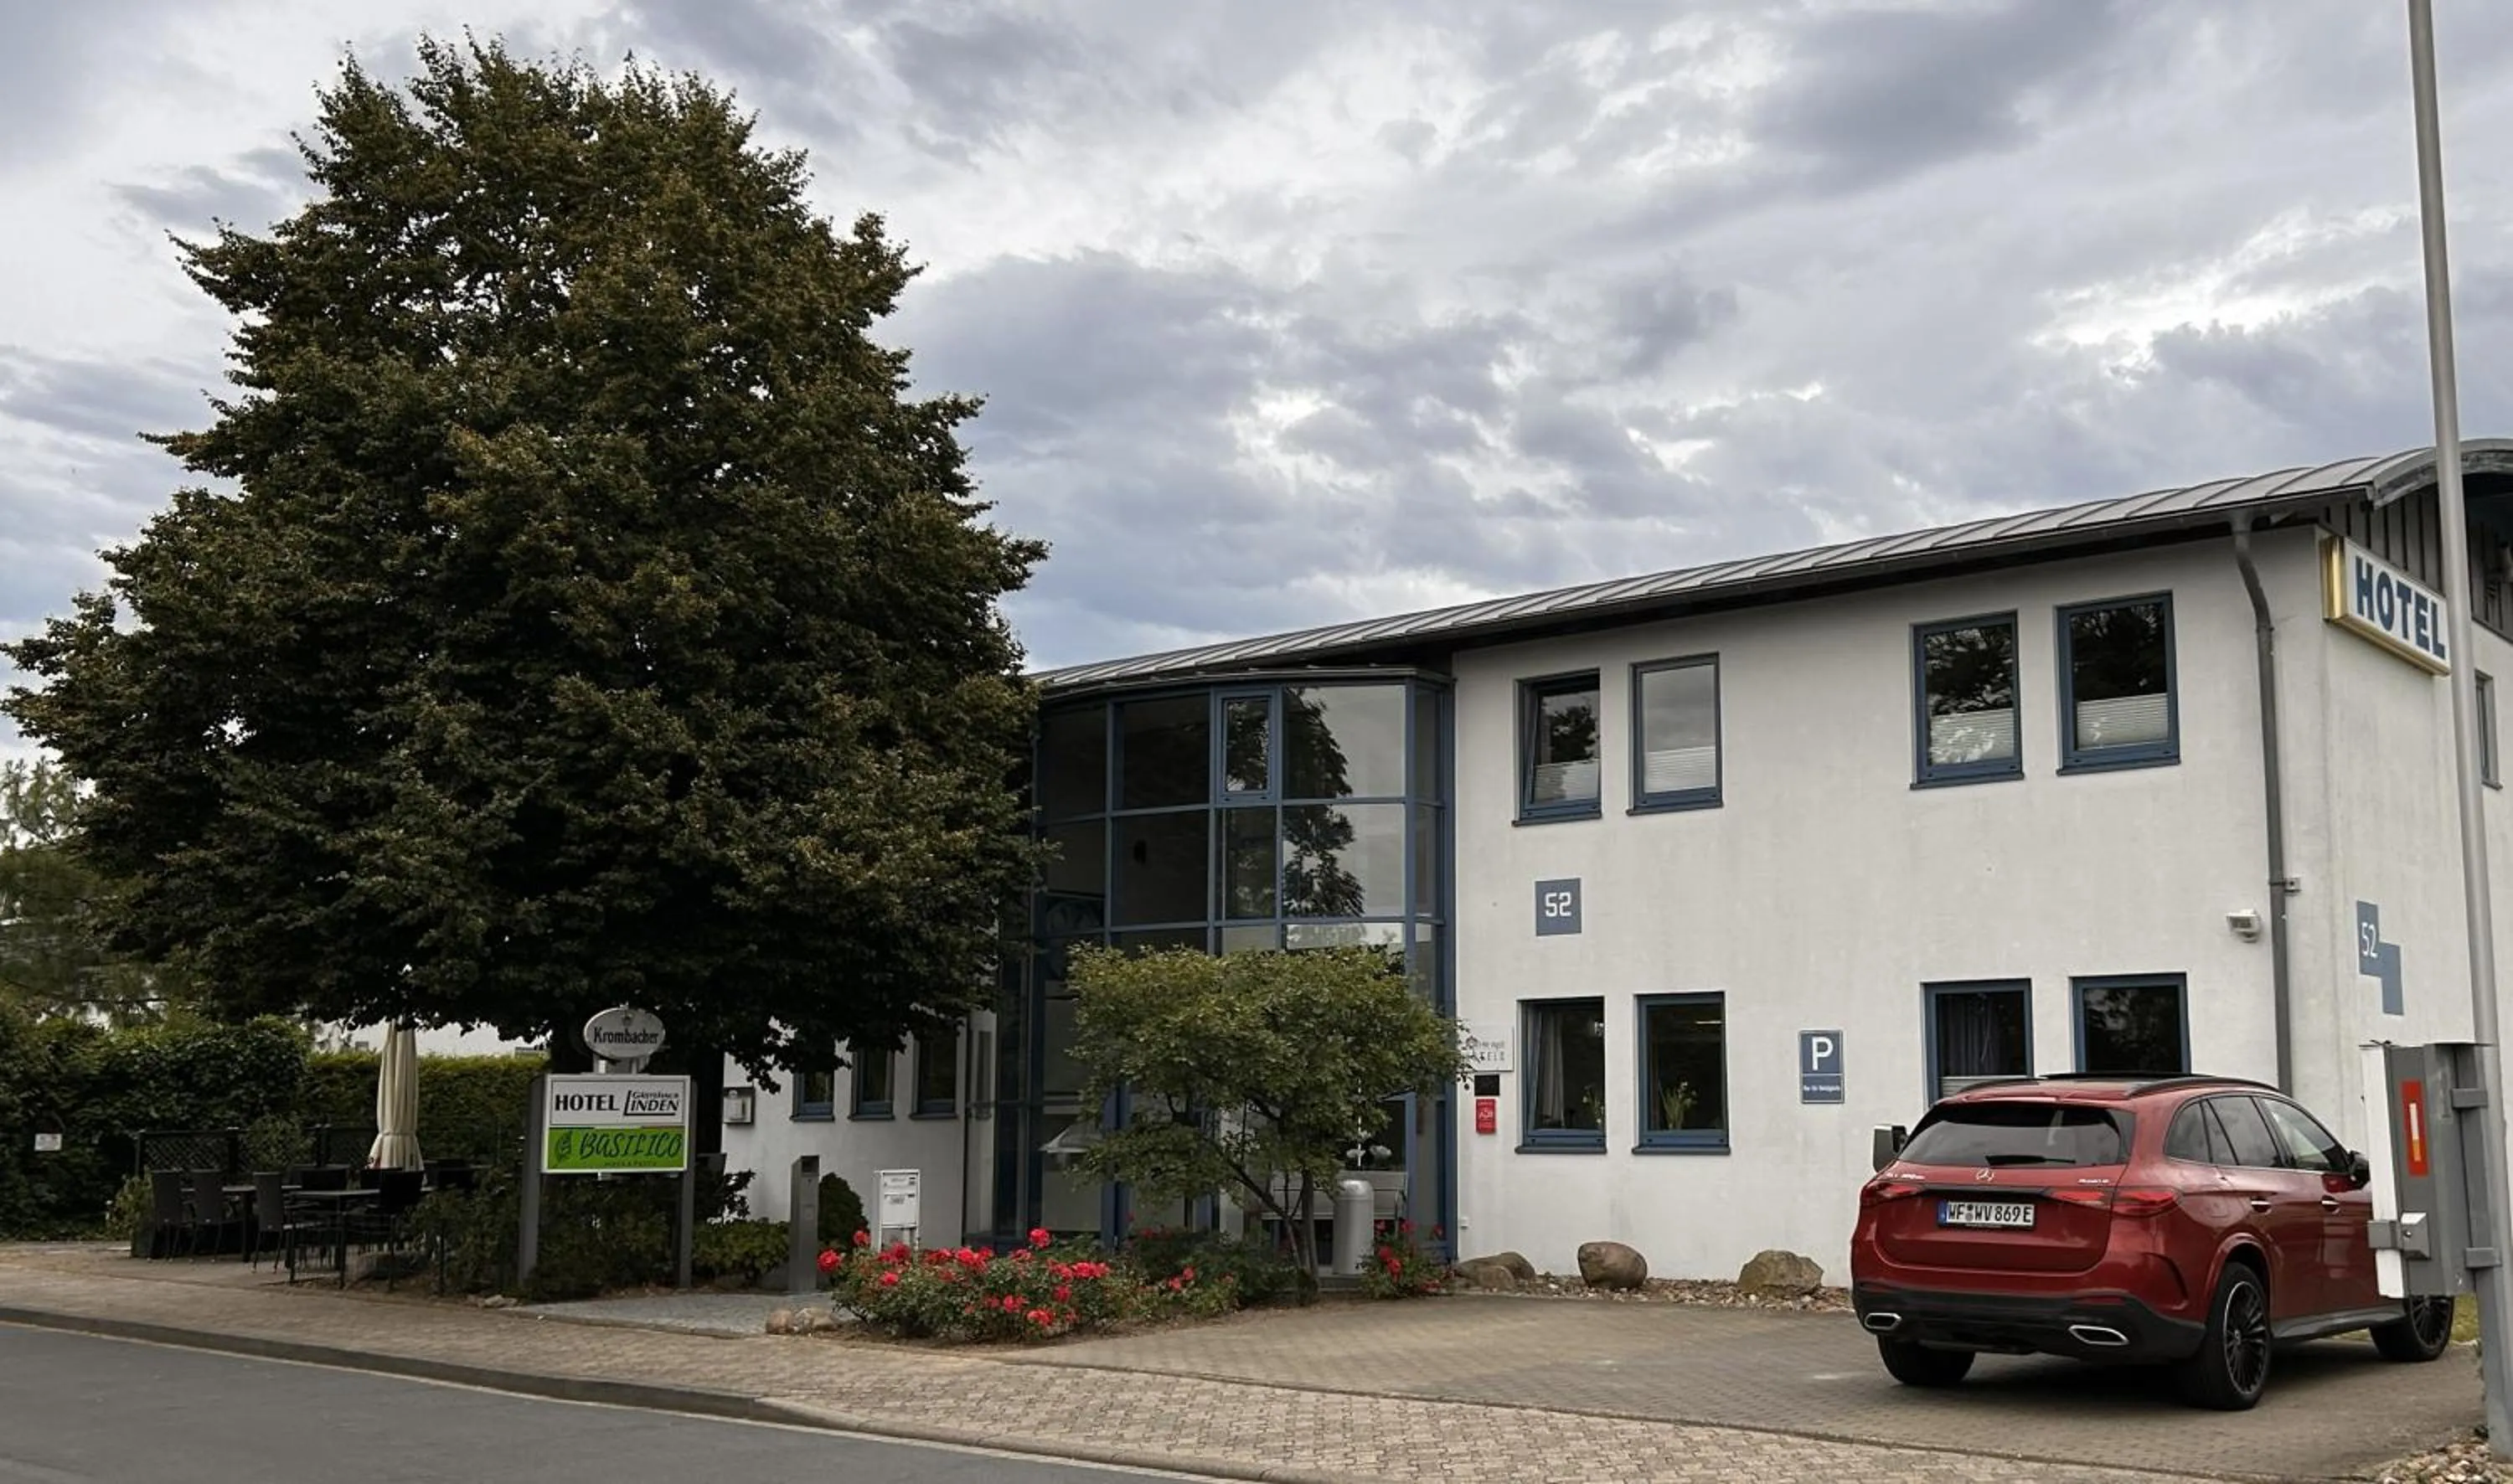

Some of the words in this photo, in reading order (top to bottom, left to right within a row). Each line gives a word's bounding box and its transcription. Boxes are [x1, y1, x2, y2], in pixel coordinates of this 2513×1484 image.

[2356, 555, 2445, 660] HOTEL
[1545, 891, 1571, 917] 52
[2361, 922, 2378, 958] 52
[594, 1027, 659, 1043] Krombacher
[1812, 1037, 1833, 1070] P
[555, 1095, 620, 1111] HOTEL
[580, 1131, 683, 1160] BASILICO
